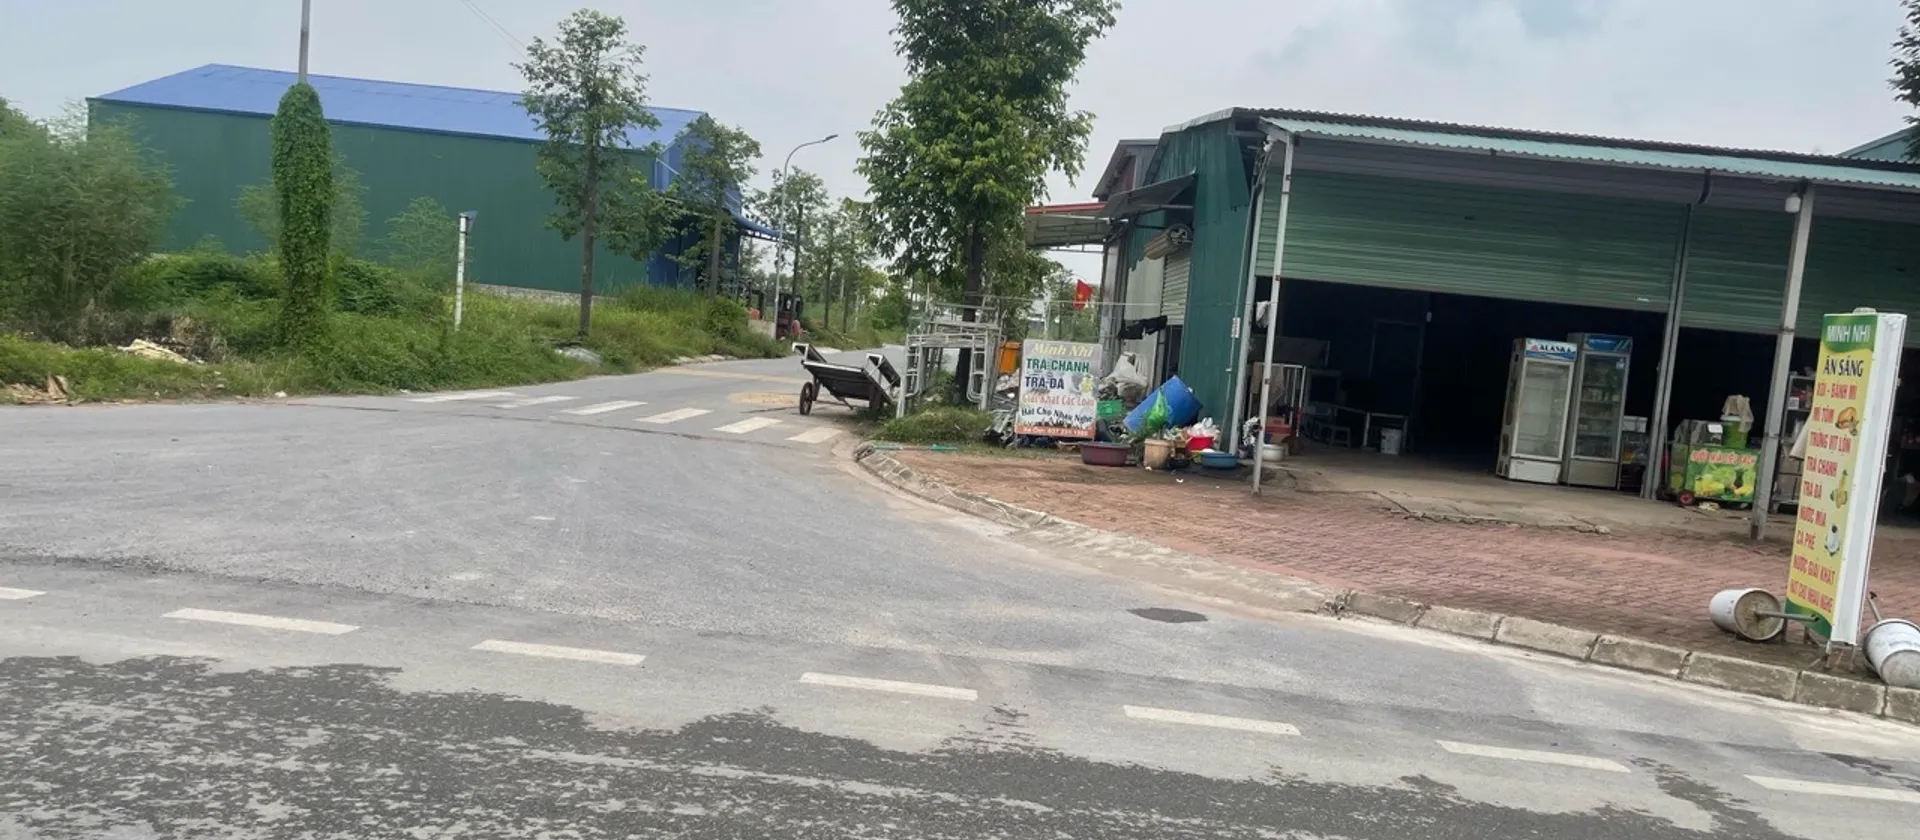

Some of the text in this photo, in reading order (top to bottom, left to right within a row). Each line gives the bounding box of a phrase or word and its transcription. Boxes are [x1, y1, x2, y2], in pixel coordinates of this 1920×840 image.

[1826, 324, 1871, 343] MINH NHI
[1032, 343, 1066, 355] Minh
[1051, 359, 1090, 373] CHANH
[1838, 355, 1864, 377] SÁNG
